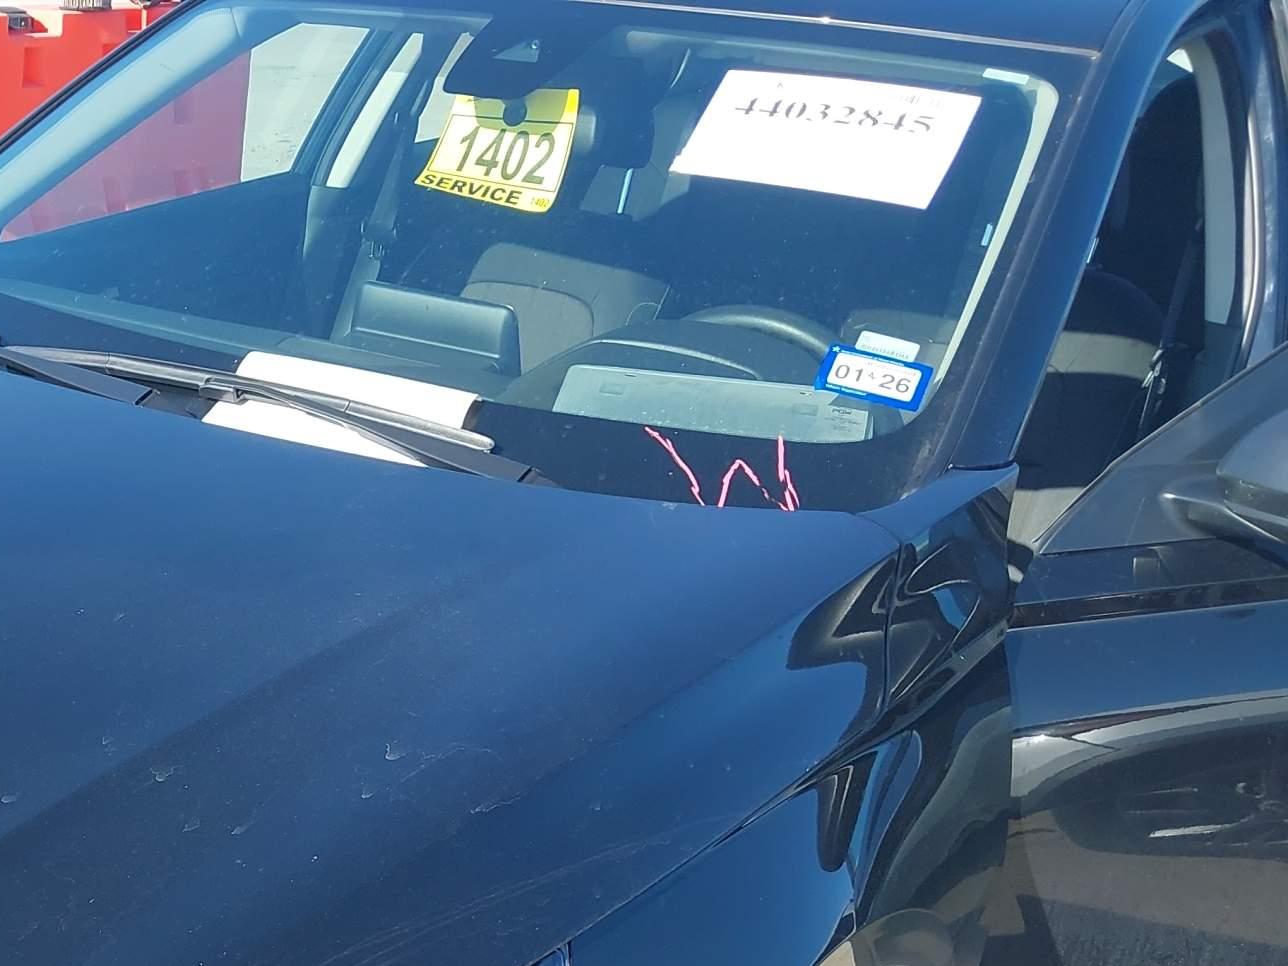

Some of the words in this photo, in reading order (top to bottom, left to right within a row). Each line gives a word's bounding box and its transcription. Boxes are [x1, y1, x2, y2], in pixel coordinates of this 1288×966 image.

[734, 98, 936, 133] 44032845
[455, 124, 556, 185] 1402
[420, 174, 523, 206] SERVICE
[834, 363, 864, 383] 01
[878, 373, 912, 394] 26
